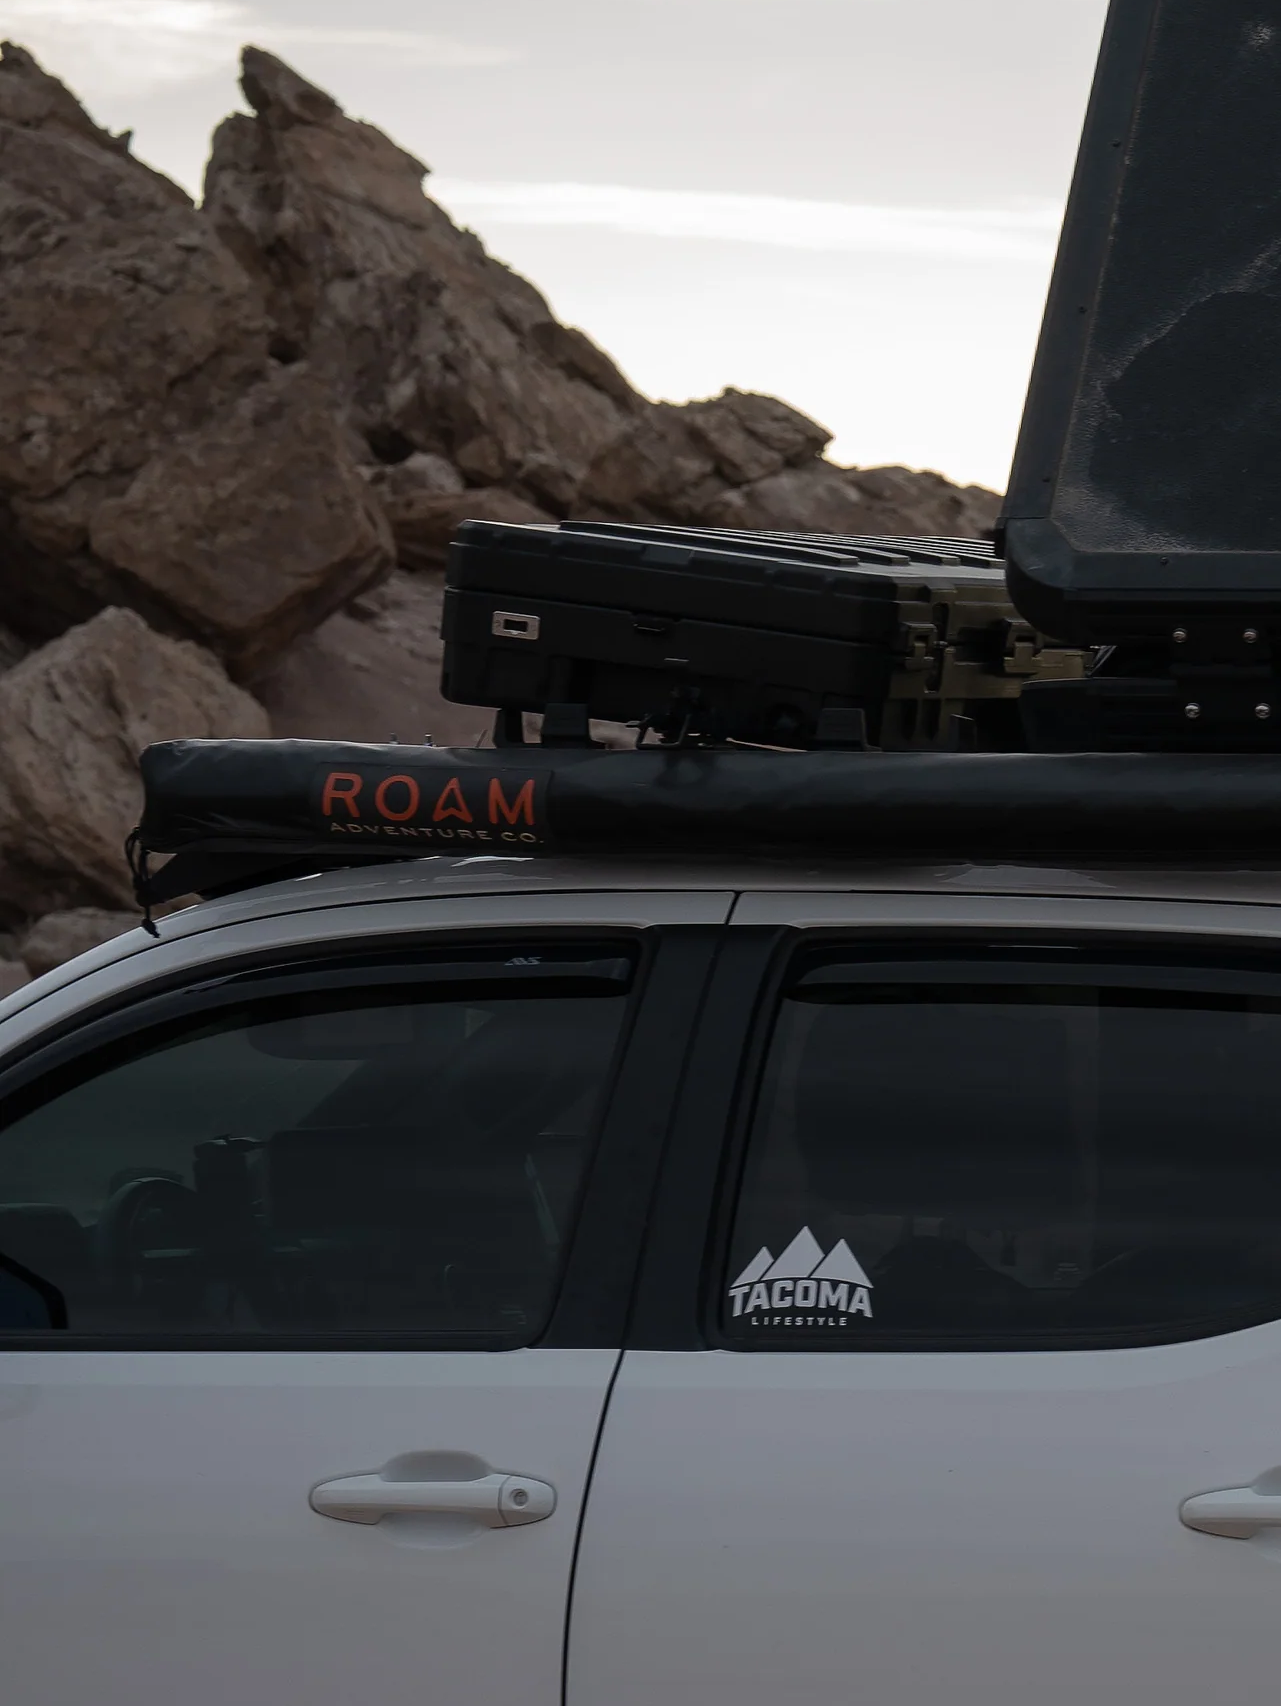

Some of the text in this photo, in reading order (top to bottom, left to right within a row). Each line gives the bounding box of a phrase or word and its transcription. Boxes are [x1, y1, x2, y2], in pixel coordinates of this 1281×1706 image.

[321, 771, 536, 826] ROAM
[330, 822, 545, 844] ADVENTURE CO.
[728, 1280, 874, 1317] TACOMA
[751, 1316, 848, 1326] LIFESTYLE
